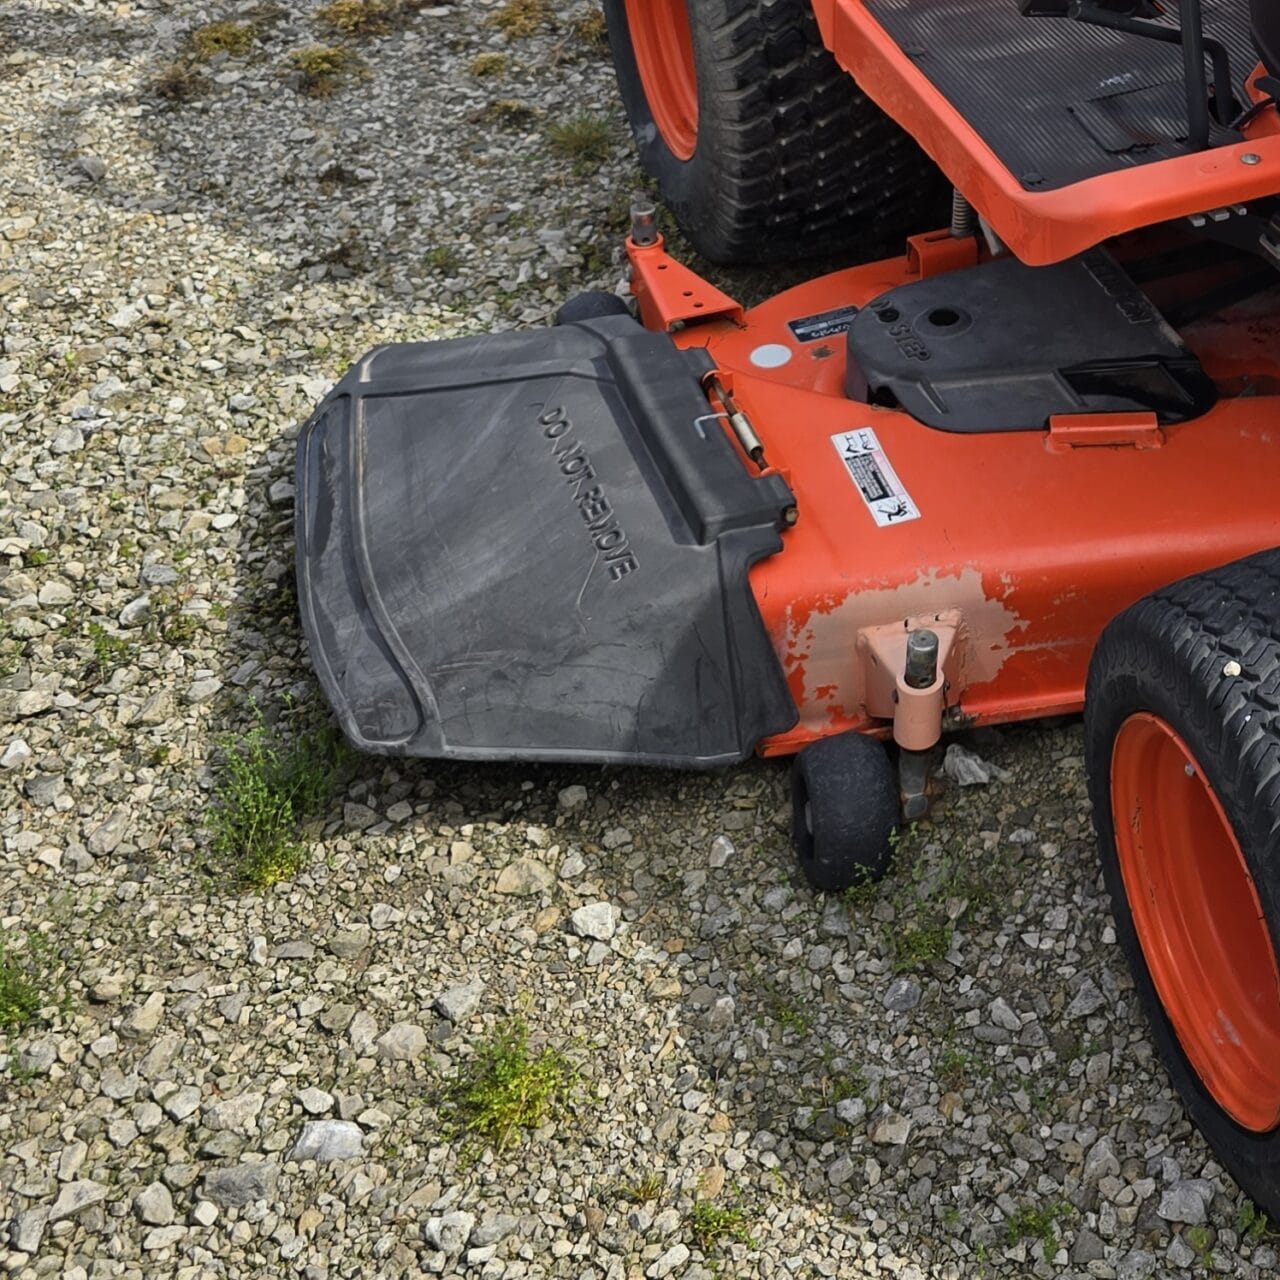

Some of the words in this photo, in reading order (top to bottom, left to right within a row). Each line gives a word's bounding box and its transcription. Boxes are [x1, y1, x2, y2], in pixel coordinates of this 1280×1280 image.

[888, 324, 932, 362] STEP
[538, 405, 574, 439] DO
[553, 439, 597, 486] NOT
[573, 484, 640, 582] REMOVE
